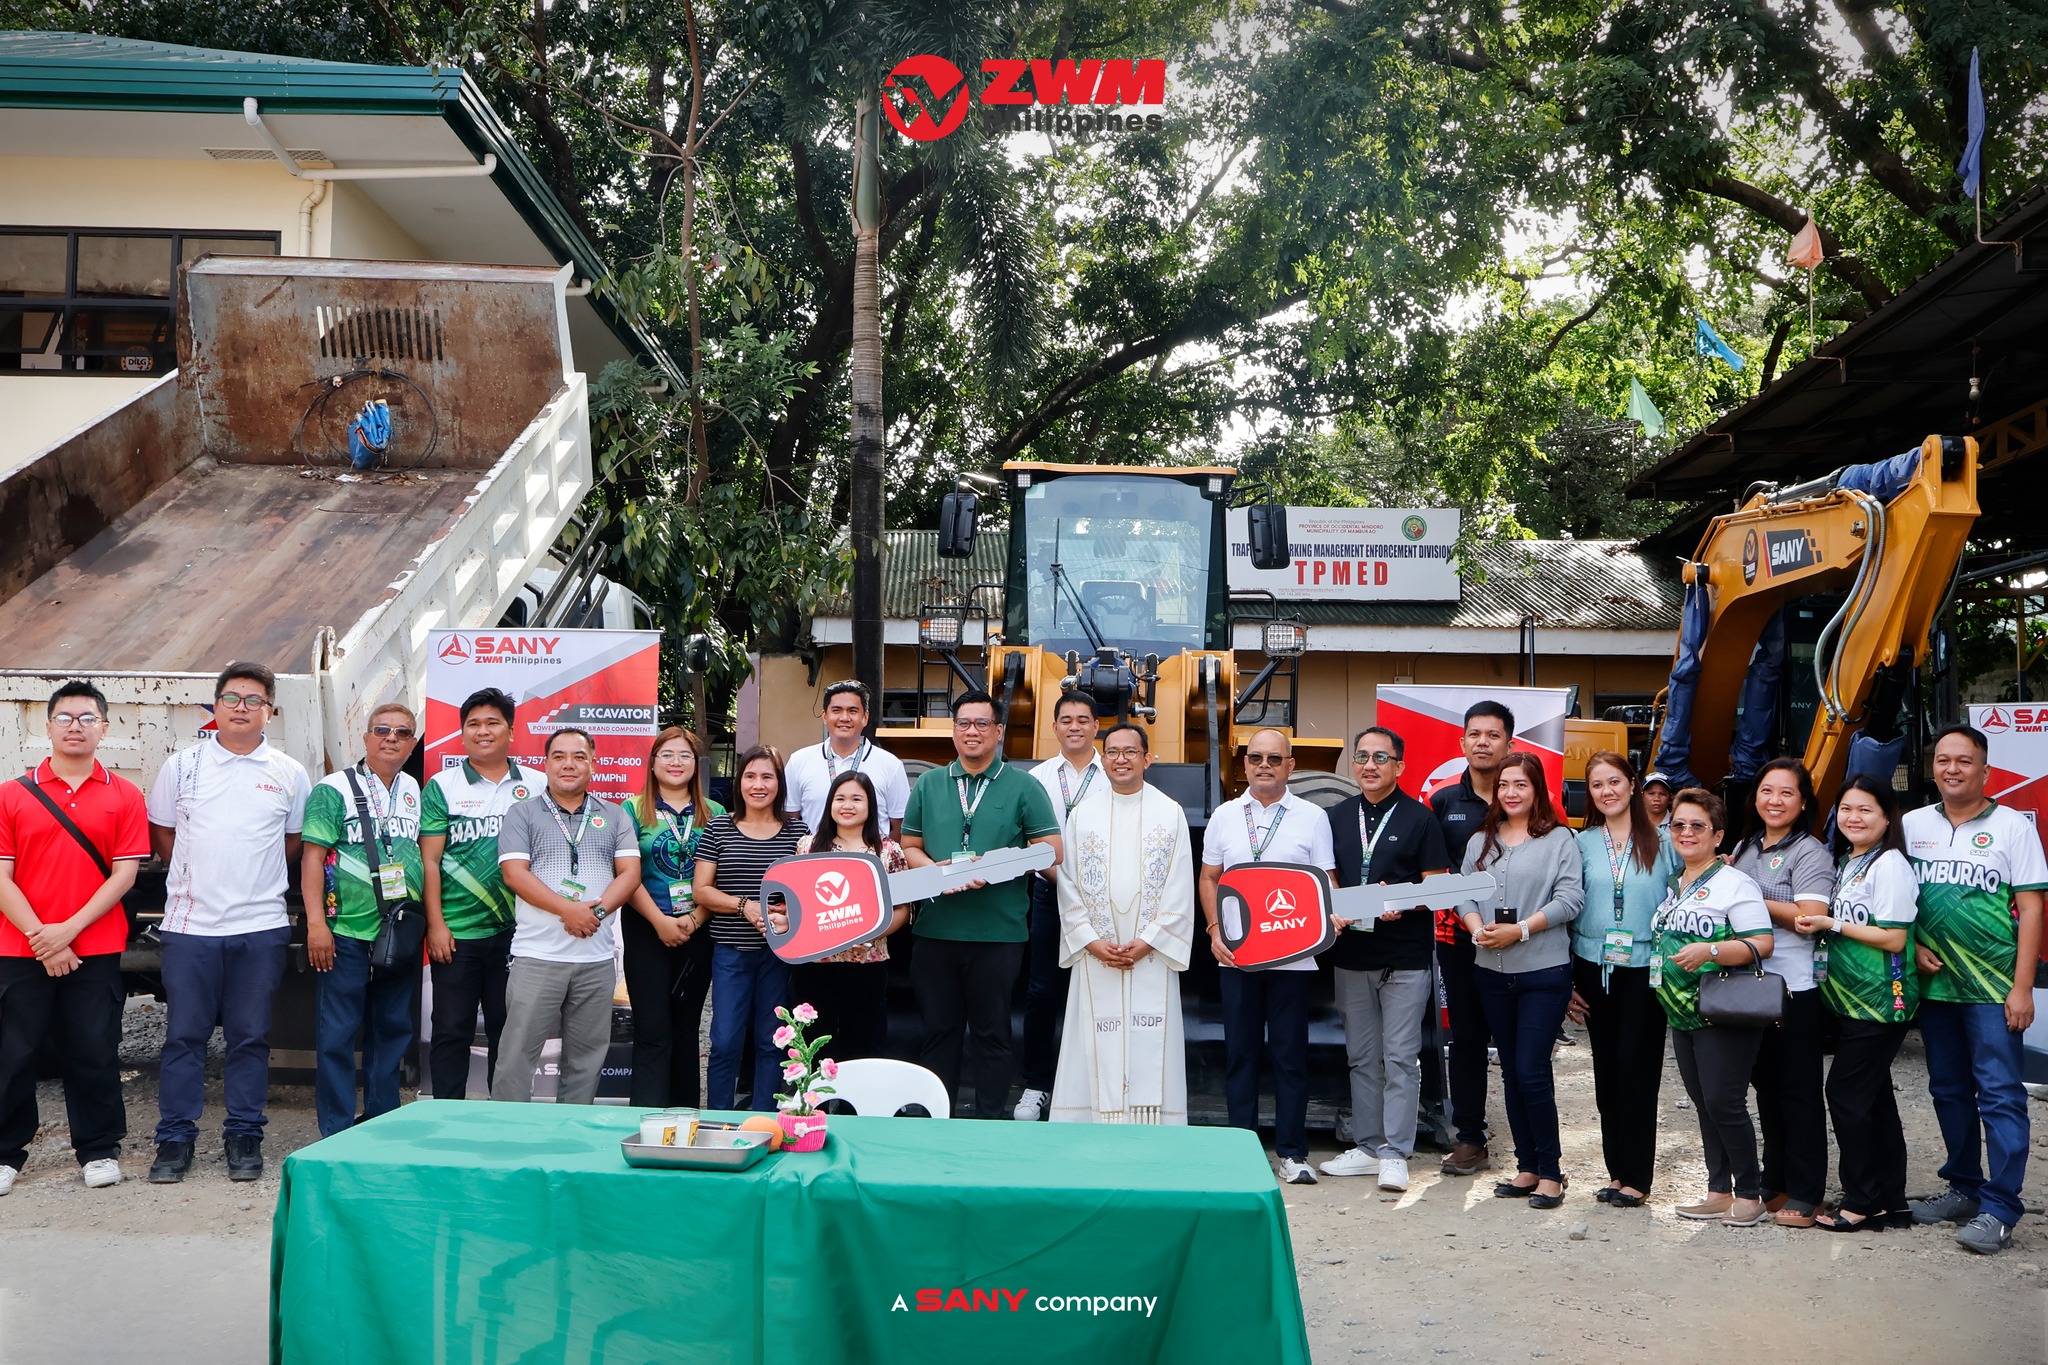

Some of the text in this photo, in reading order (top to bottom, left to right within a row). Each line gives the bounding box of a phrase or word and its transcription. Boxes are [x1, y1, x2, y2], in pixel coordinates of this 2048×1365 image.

[128, 358, 147, 366] DILG
[1231, 543, 1452, 559] TRAF RKING MANAGEMENT ENFORCEMENT DIVISION
[1771, 537, 1805, 567] SANY
[1294, 561, 1389, 585] TPMED
[475, 637, 561, 655] SANY
[504, 656, 562, 665] Philippines
[579, 707, 651, 720] EXCAVATOR
[2013, 709, 2048, 725] SA
[590, 773, 627, 783] WMPhil
[264, 784, 282, 792] SANY
[450, 815, 503, 845] MAMB
[1969, 849, 1989, 858] SAM
[816, 903, 862, 925] ZWM
[818, 916, 864, 932] Philippines
[1259, 916, 1308, 933] SANY
[1096, 1015, 1163, 1033] NSDP NSDP
[601, 1067, 633, 1076] COMPA
